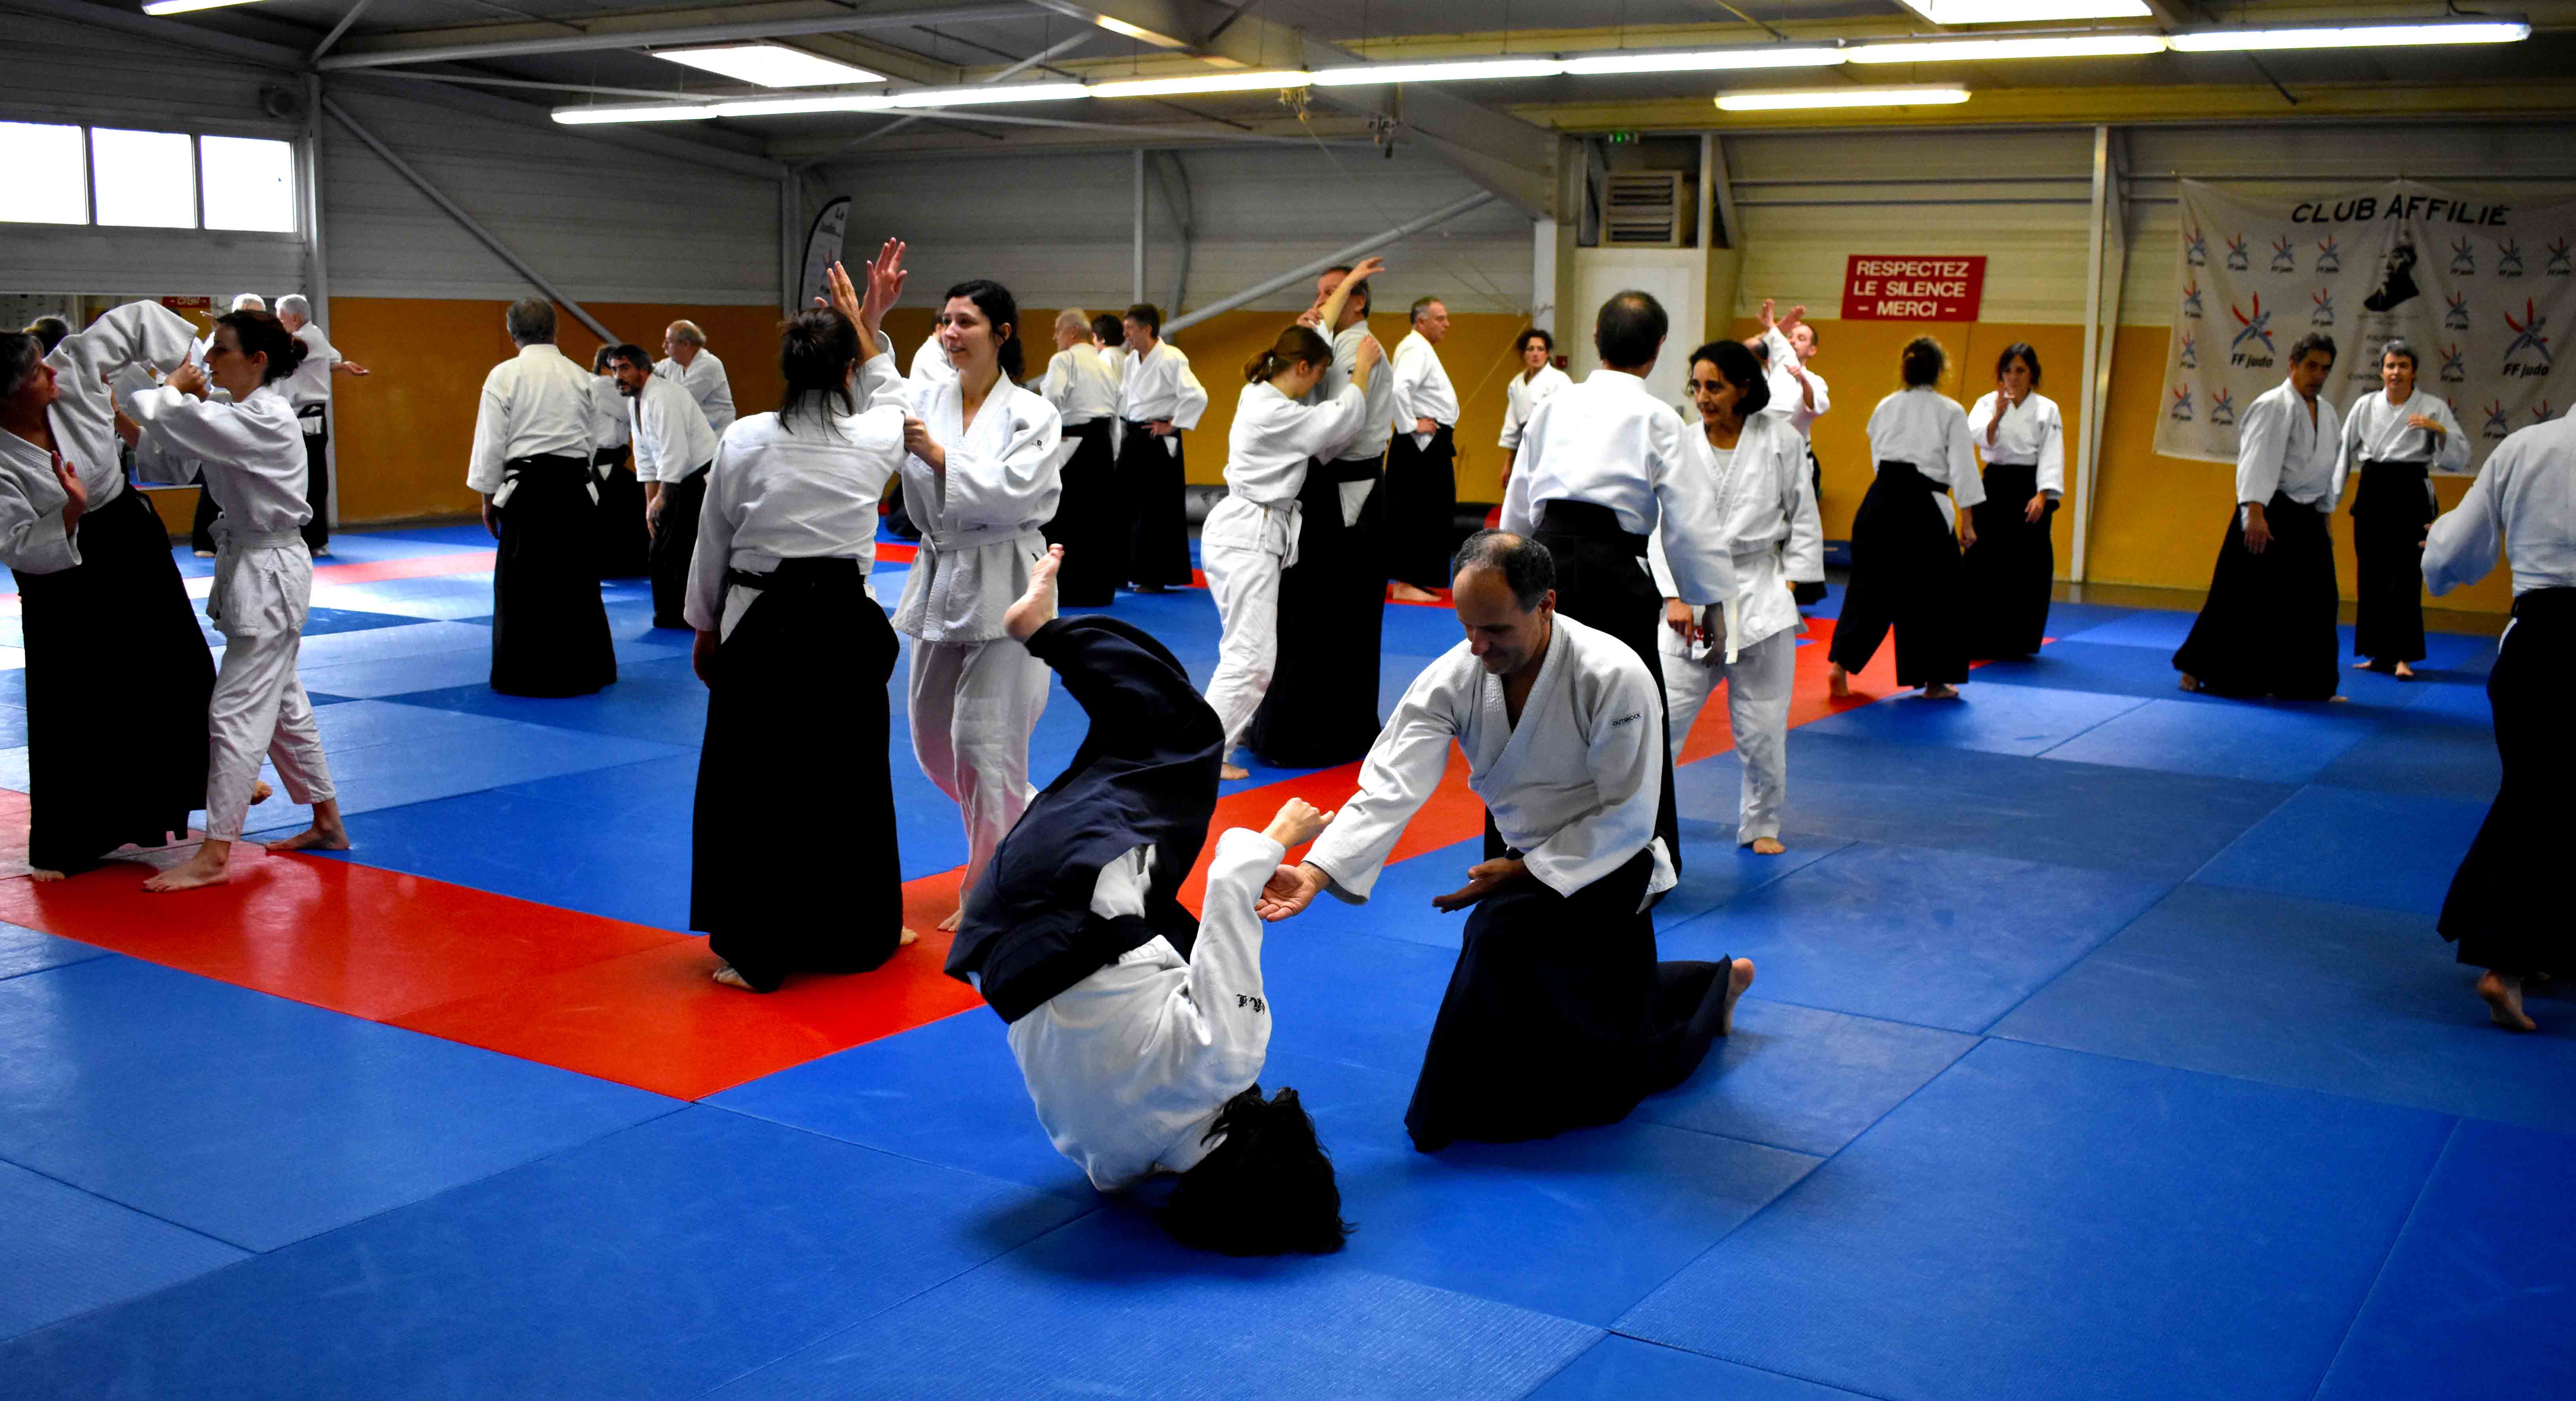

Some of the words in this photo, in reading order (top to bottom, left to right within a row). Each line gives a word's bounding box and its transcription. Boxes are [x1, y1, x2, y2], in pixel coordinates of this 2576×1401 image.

[2292, 197, 2377, 223] CLUB
[1856, 260, 1970, 277] RESPECTEZ
[1853, 280, 1878, 296] LE
[1885, 281, 1967, 297] SILENCE
[1876, 300, 1938, 316] MERCI
[2231, 353, 2246, 365] FF
[2245, 354, 2273, 369] judo
[2501, 363, 2521, 376] FF
[2520, 363, 2550, 378] judo
[1612, 712, 1642, 726] OUTSHOCK
